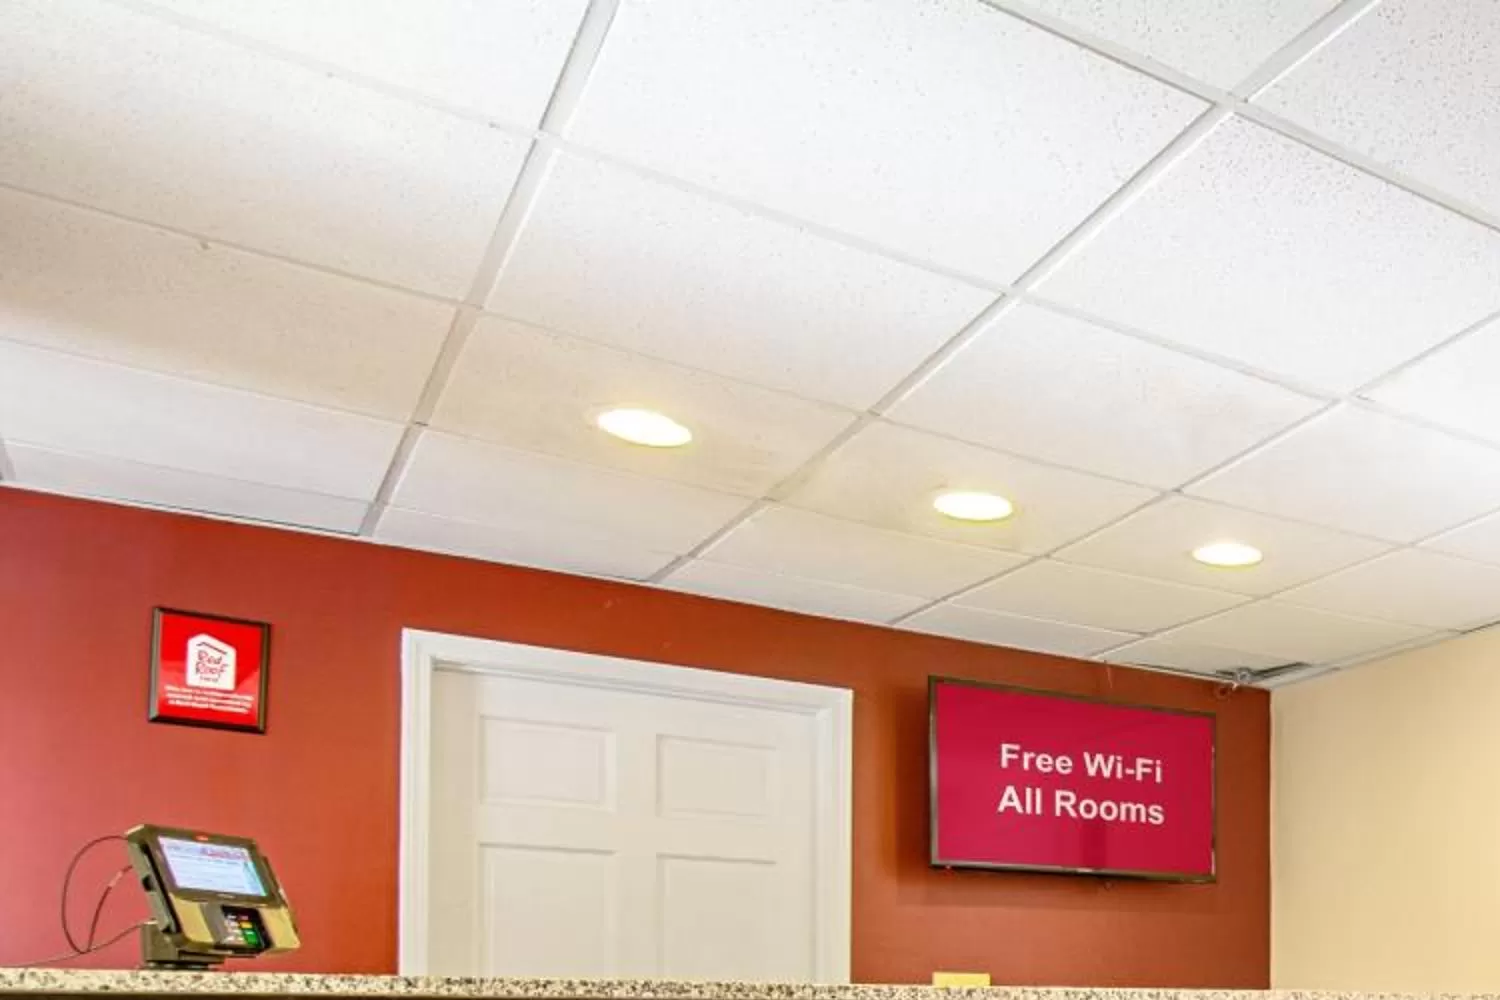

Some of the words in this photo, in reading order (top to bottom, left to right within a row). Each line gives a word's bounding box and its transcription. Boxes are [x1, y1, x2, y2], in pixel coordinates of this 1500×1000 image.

[1000, 743, 1073, 775] Free
[1083, 752, 1163, 784] Wi-Fi
[997, 785, 1042, 815] All
[1055, 790, 1165, 825] Rooms
